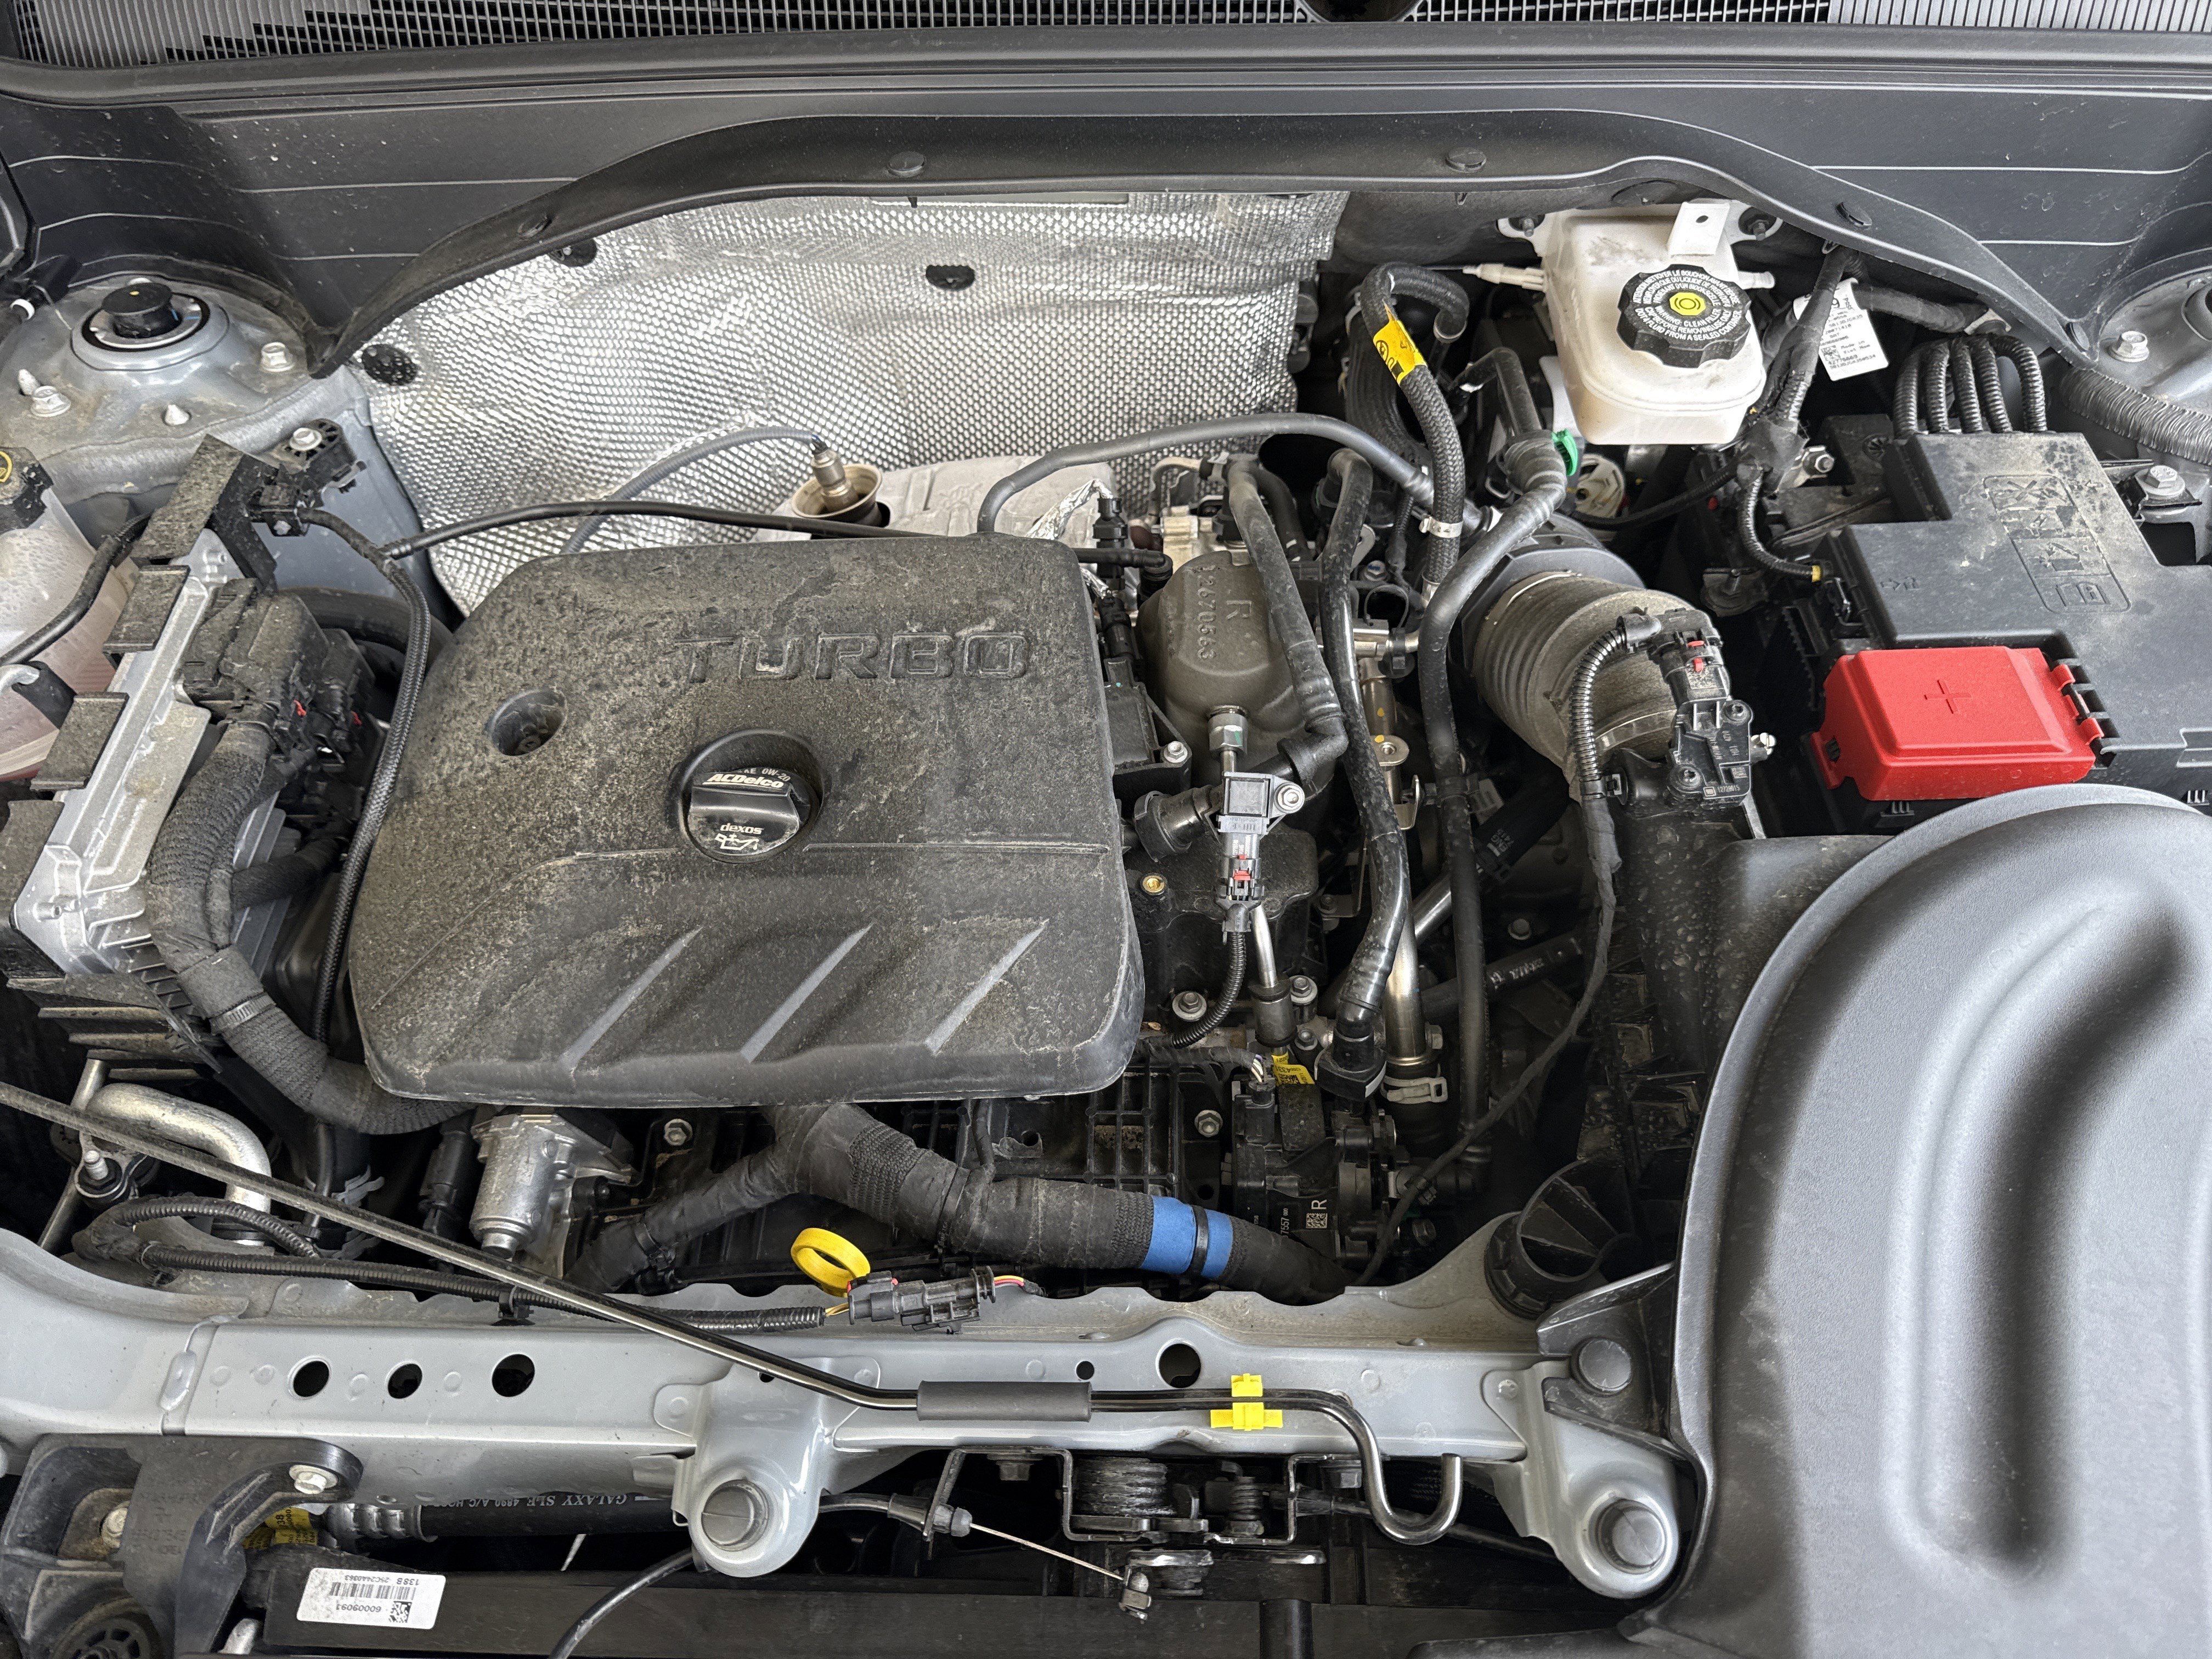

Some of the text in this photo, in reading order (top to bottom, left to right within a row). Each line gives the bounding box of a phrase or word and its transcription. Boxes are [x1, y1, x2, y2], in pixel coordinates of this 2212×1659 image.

[1683, 318, 1708, 327] CLEAN
[1663, 330, 1686, 340] FROM
[1694, 330, 1720, 341] SEALED
[1226, 600, 1251, 620] R
[674, 631, 1031, 684] TURBO
[707, 773, 785, 788] ACDelco
[761, 768, 791, 782] 0W-20
[720, 823, 764, 834] dexos
[1311, 1199, 1328, 1210] R
[469, 1498, 489, 1508] A/C
[495, 1498, 520, 1508] 4890
[526, 1494, 556, 1506] SLE
[562, 1493, 628, 1506] GALAXY
[396, 1577, 420, 1587] 138B
